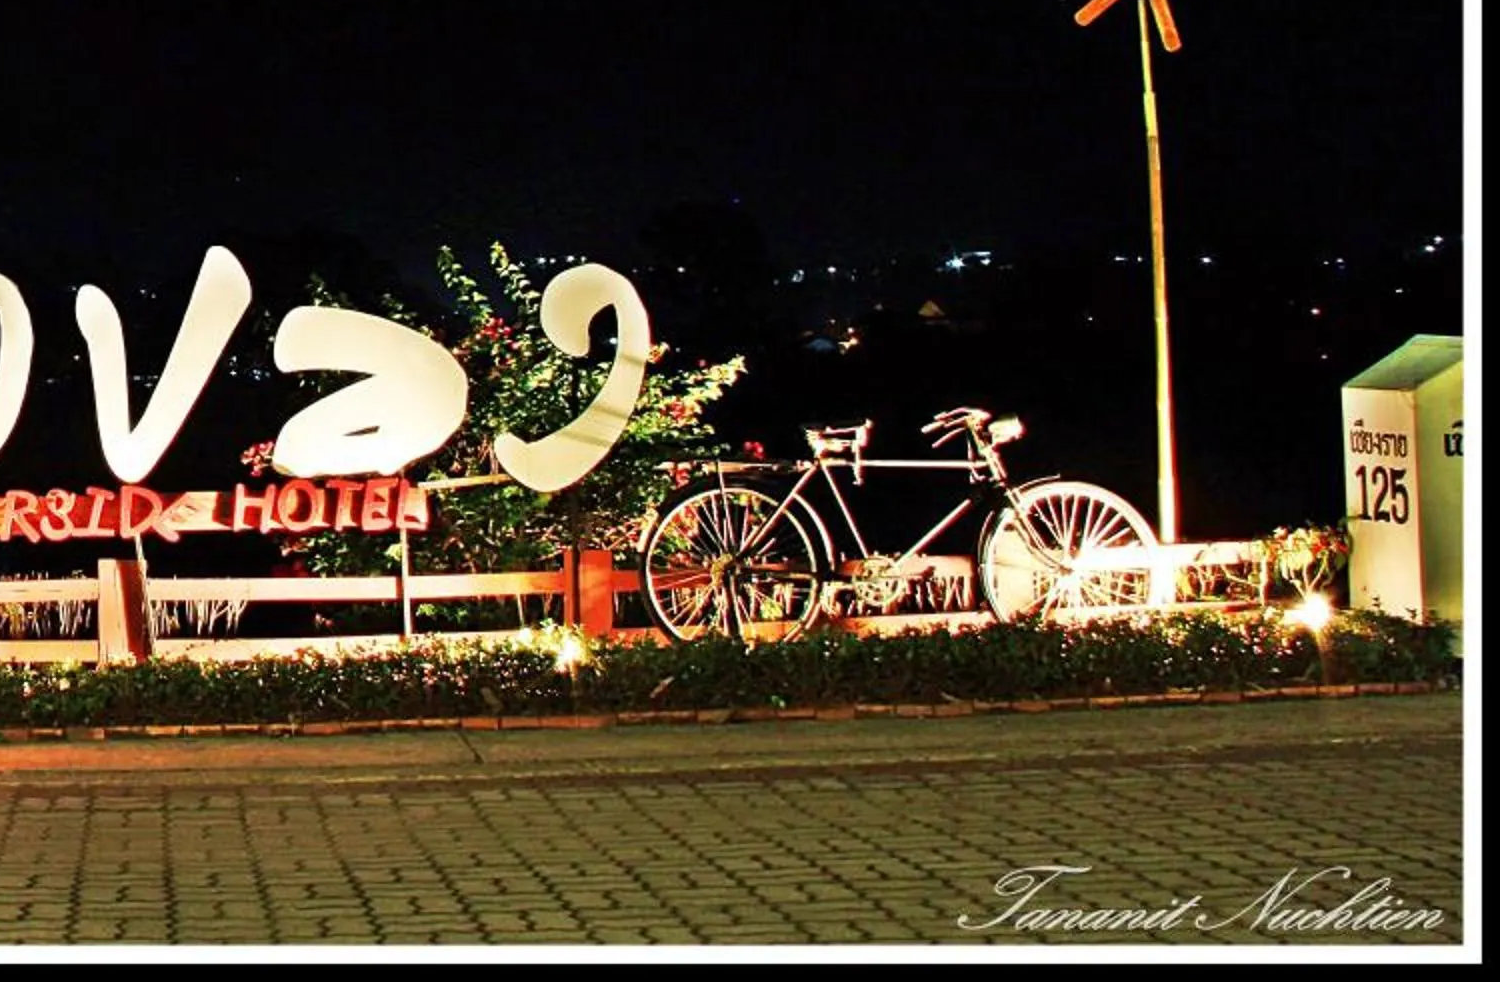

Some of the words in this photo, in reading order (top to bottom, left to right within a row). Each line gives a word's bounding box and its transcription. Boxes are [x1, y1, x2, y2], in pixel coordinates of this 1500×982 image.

[1349, 418, 1408, 459] เชียงราย
[233, 478, 428, 531] HOTEL
[1355, 464, 1409, 524] 125
